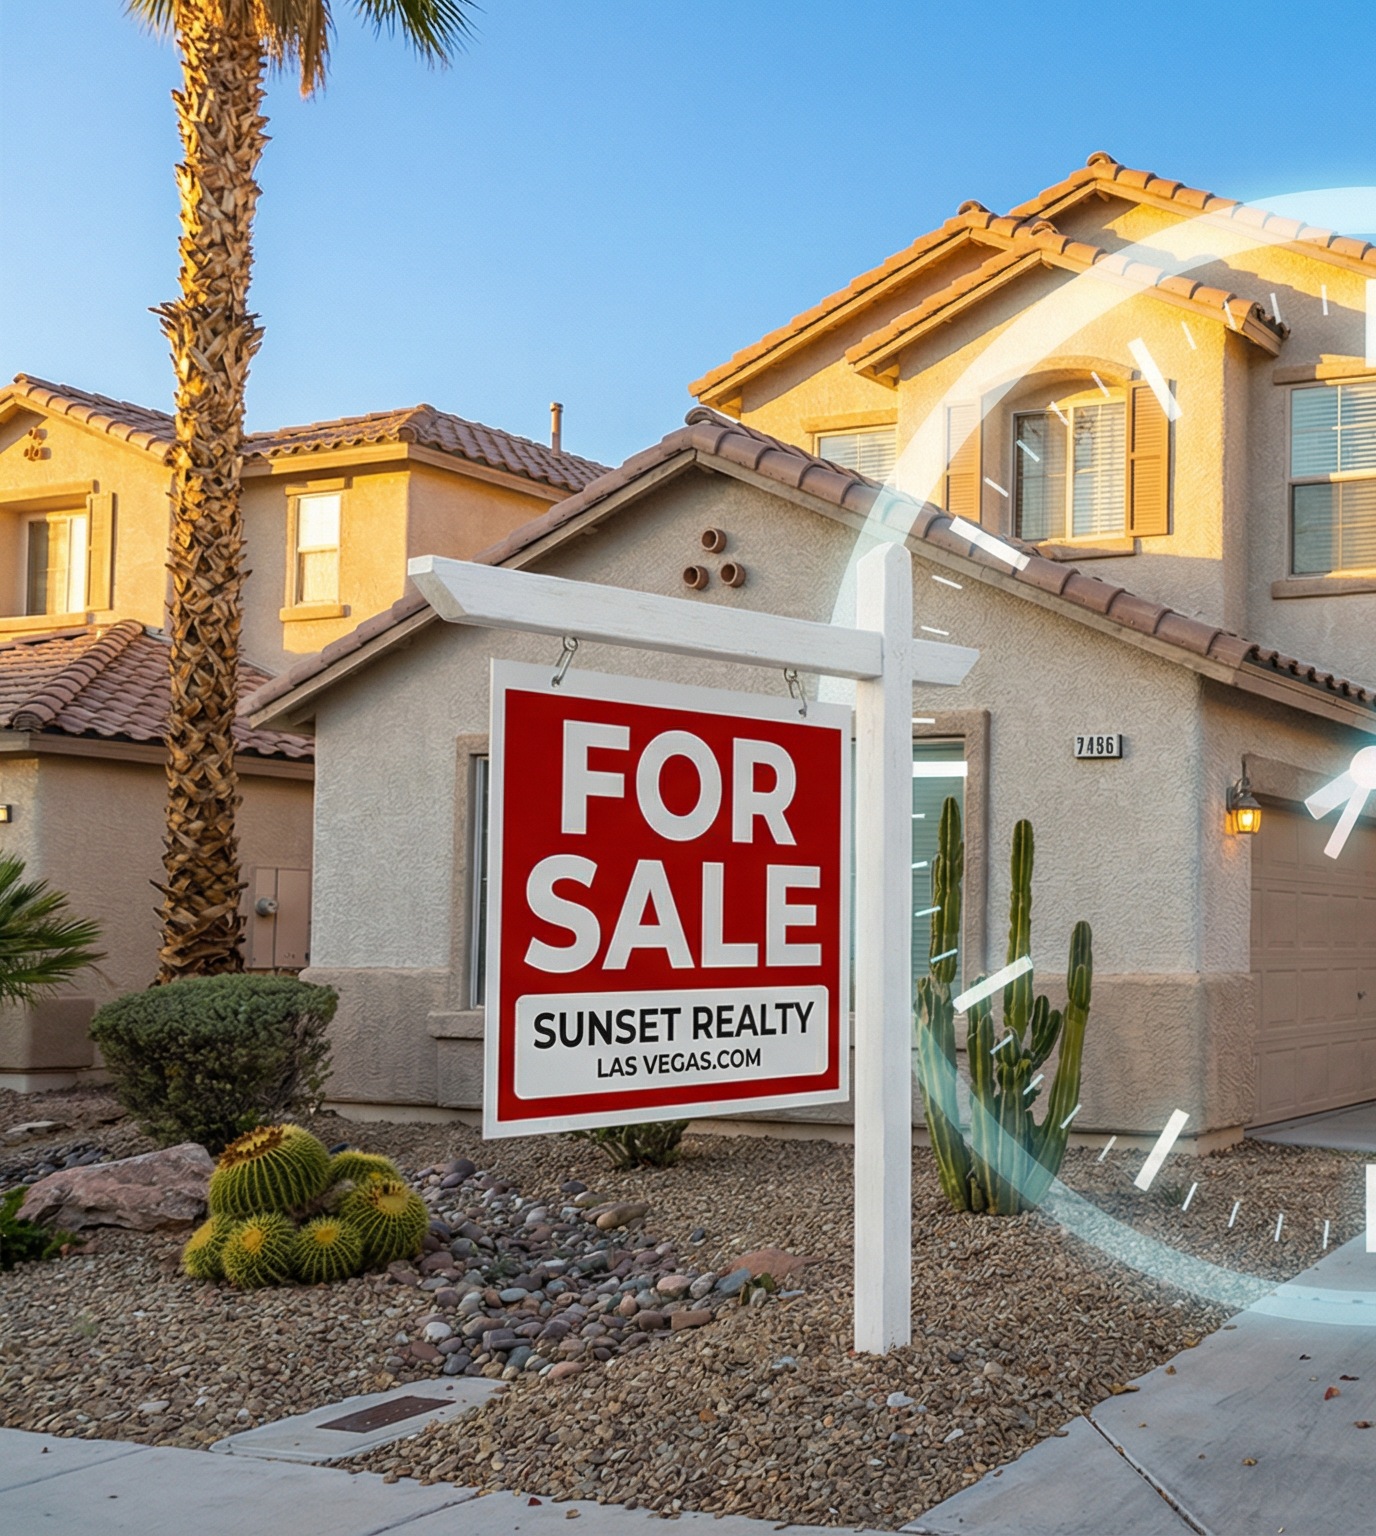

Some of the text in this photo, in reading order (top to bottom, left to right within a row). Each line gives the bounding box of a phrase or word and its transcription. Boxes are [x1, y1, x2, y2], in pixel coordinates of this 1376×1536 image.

[561, 719, 797, 846] FOR
[523, 853, 822, 974] SALE
[532, 1001, 815, 1050] SUNSET REALTY
[597, 1048, 762, 1079] LAS VEGAS.COM
